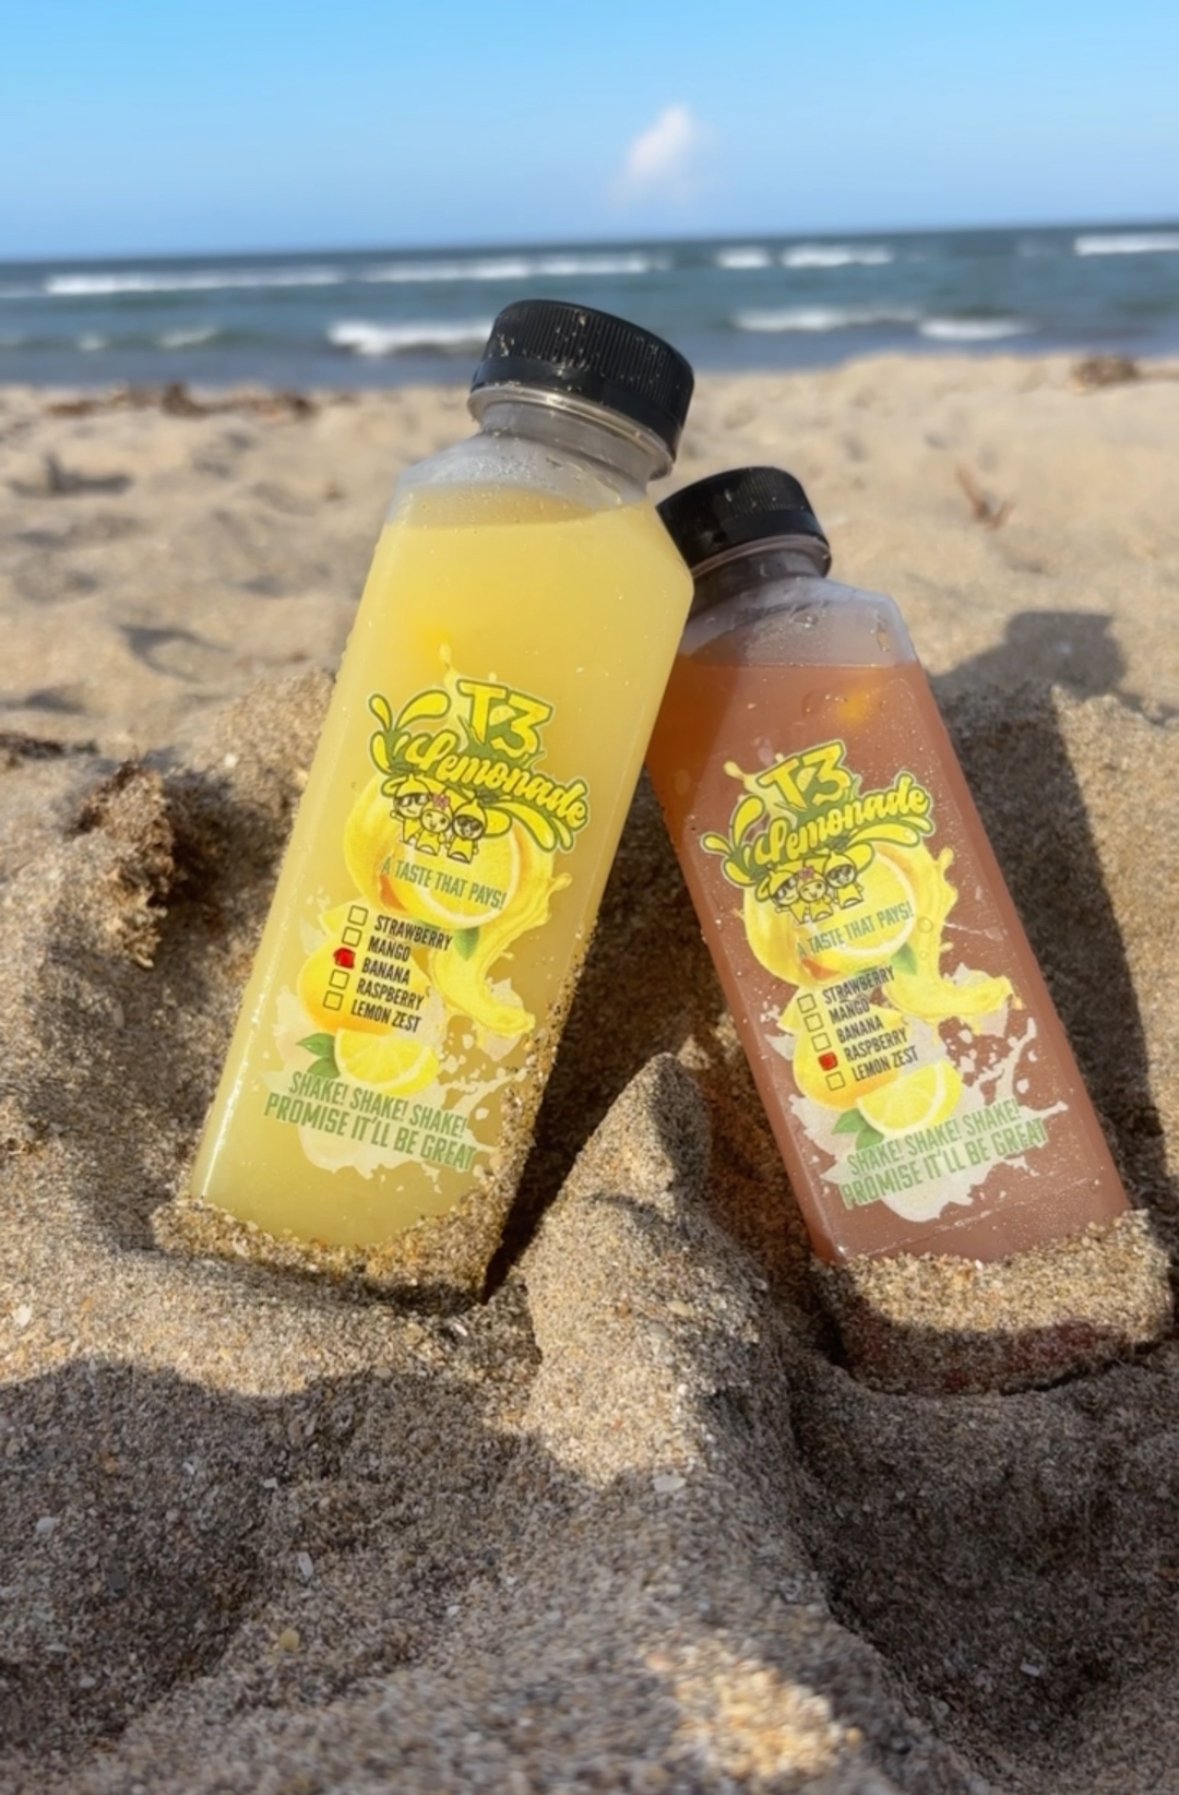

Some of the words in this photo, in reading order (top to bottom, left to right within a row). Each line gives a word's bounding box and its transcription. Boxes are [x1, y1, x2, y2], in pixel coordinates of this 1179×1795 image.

[457, 679, 554, 758] T3
[405, 729, 589, 830] Lemonade
[756, 741, 852, 809] T3
[754, 773, 930, 865] Lemonade
[393, 863, 433, 889] TASTE
[434, 872, 467, 895] THAT
[471, 882, 507, 909] PAYS!
[367, 935, 411, 962] MANGO
[374, 915, 453, 951] STRAWBERRY
[808, 930, 846, 954] TASTE
[846, 916, 875, 940] THAT
[878, 901, 914, 928] PAYS!
[361, 959, 410, 985] BANANA
[822, 966, 895, 1004] STRAWBERRY
[350, 999, 391, 1026] LEMON
[392, 1011, 422, 1033] ZEST
[356, 979, 425, 1011] RASPBERRY
[829, 998, 870, 1024] MANGO
[836, 1018, 884, 1044] BANANA
[843, 1028, 908, 1062] RASPBERRY
[852, 1058, 892, 1082] LEMON
[891, 1046, 919, 1068] ZEST
[288, 1071, 348, 1105] SHAKE!
[349, 1088, 408, 1122] SHAKE!
[410, 1104, 468, 1138] SHAKE!
[264, 1093, 348, 1140] PROMISE
[351, 1116, 390, 1149] IT'LL
[395, 1130, 417, 1155] BE
[419, 1137, 477, 1170] GREAT
[846, 1144, 904, 1175] SHAKE!
[906, 1120, 962, 1156] SHAKE!
[964, 1098, 1020, 1136] SHAKE!
[840, 1166, 924, 1209] PROMISE
[925, 1148, 966, 1180] IT'LL
[968, 1138, 990, 1162] BE
[993, 1116, 1046, 1156] GREAT
